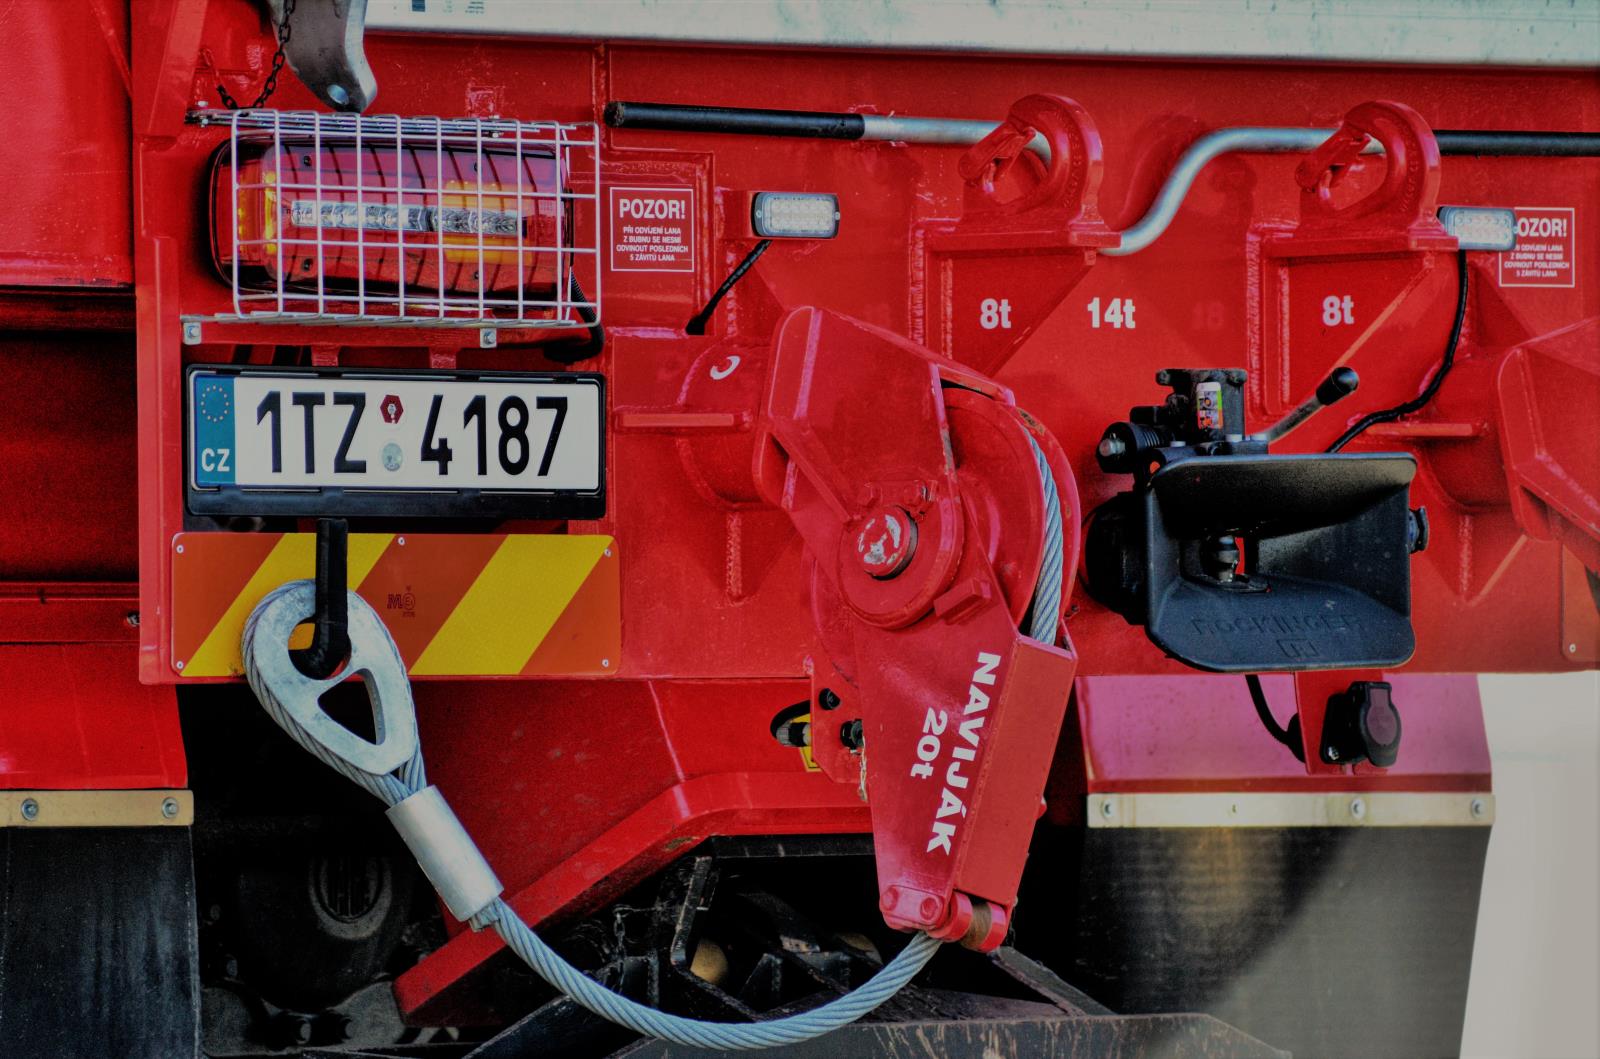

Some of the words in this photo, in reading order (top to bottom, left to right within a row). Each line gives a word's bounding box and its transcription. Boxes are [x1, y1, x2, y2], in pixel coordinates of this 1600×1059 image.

[619, 198, 686, 219] POZOR!
[623, 235, 628, 243] Z
[664, 227, 682, 235] LANA
[1517, 217, 1567, 238] OZOR!
[616, 244, 648, 252] ODVINOUT
[980, 298, 1012, 329] 8t
[1087, 297, 1136, 329] 14t
[1322, 295, 1354, 326] 8t
[256, 390, 367, 474] 1TZ
[420, 394, 569, 477] 4187
[201, 447, 230, 472] CZ
[910, 707, 948, 779] 20t
[926, 651, 1002, 856] NAVIJÁK
